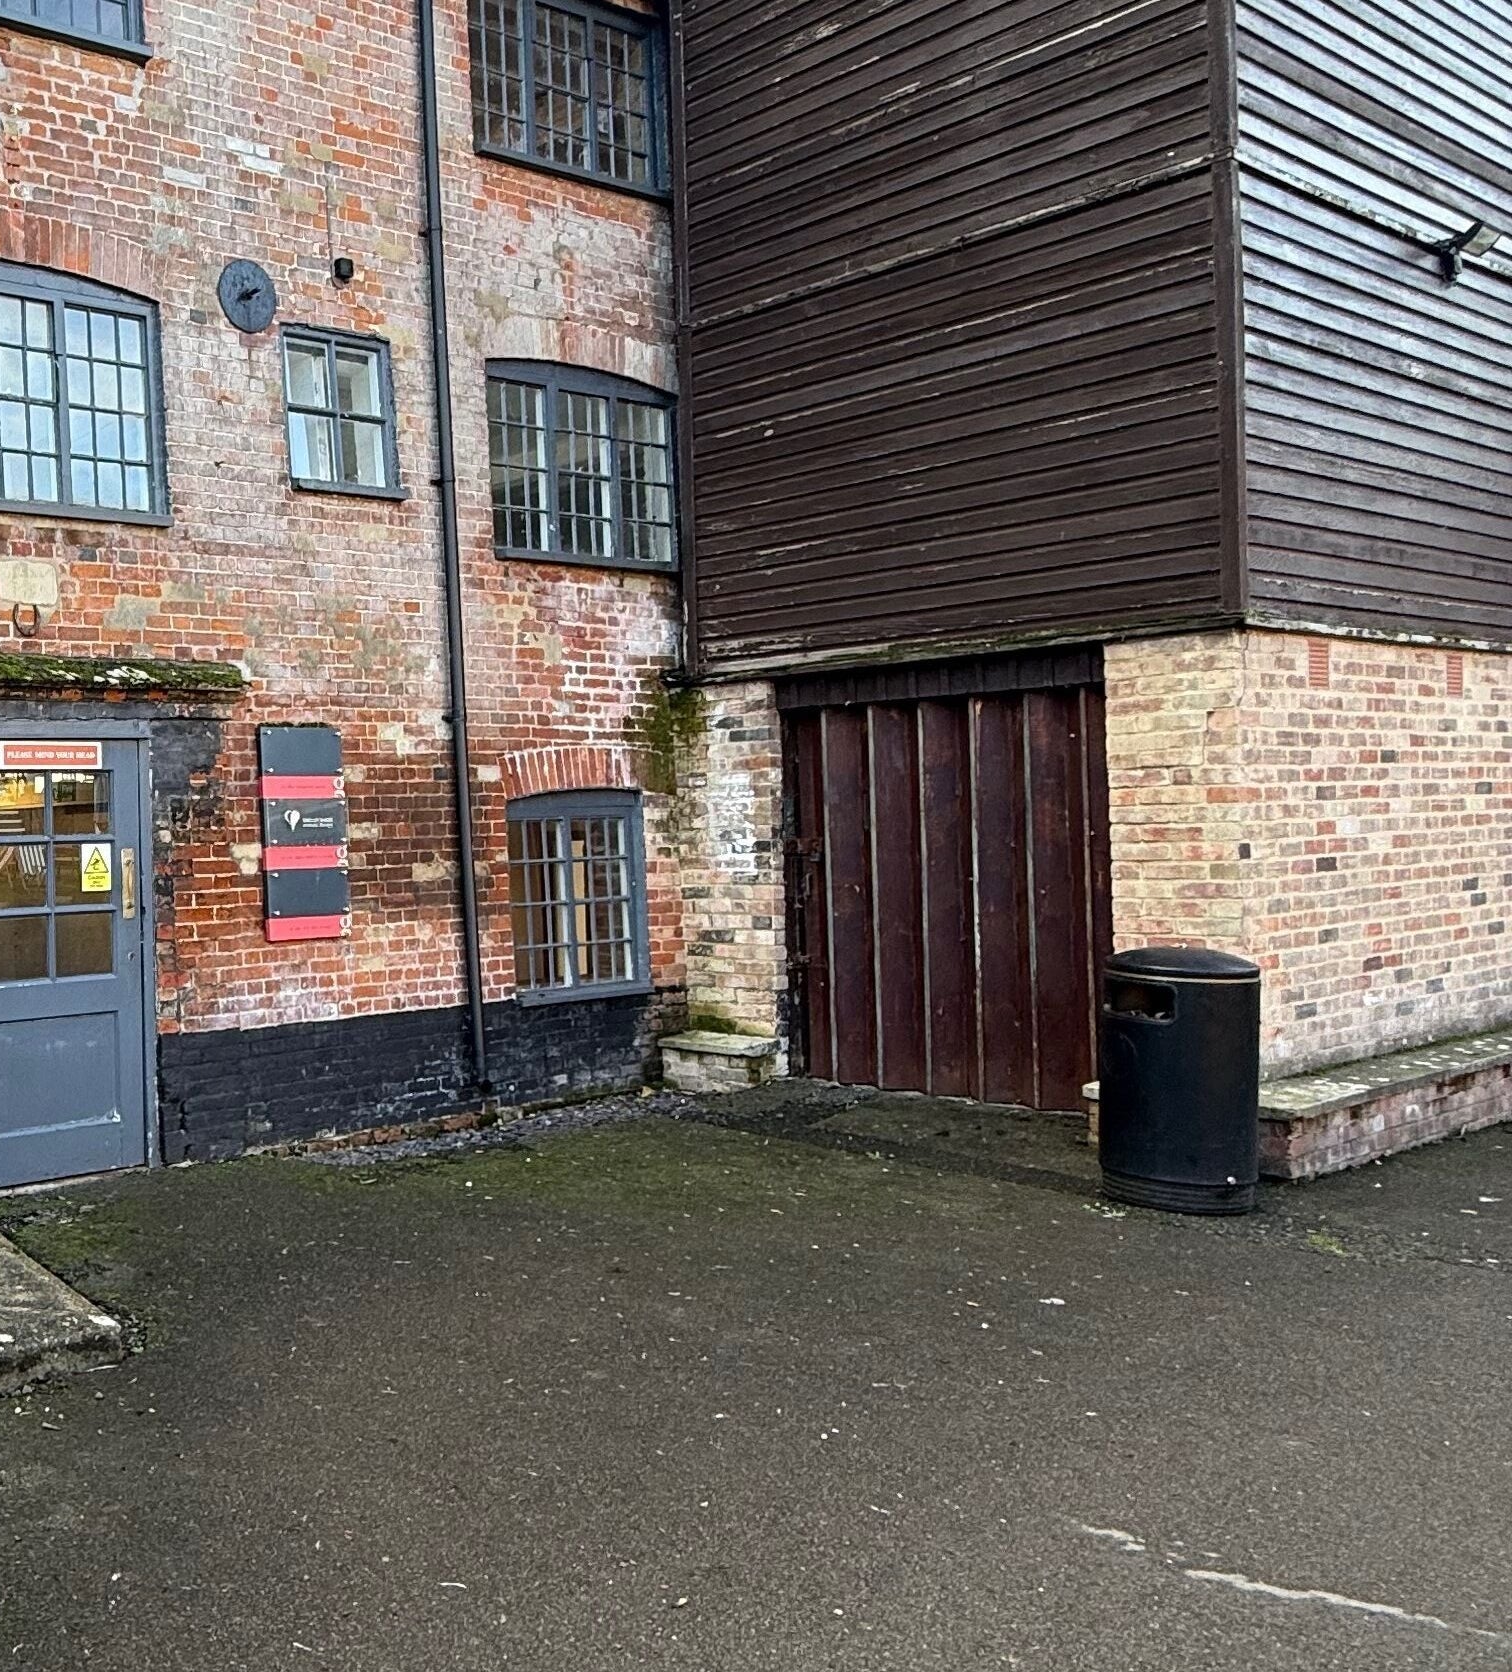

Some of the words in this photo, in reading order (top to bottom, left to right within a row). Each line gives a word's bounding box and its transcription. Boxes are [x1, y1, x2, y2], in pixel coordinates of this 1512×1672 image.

[6, 751, 33, 759] PLEASE
[34, 751, 55, 759] MIND
[55, 751, 75, 760] YOUR
[75, 751, 96, 759] HEAD
